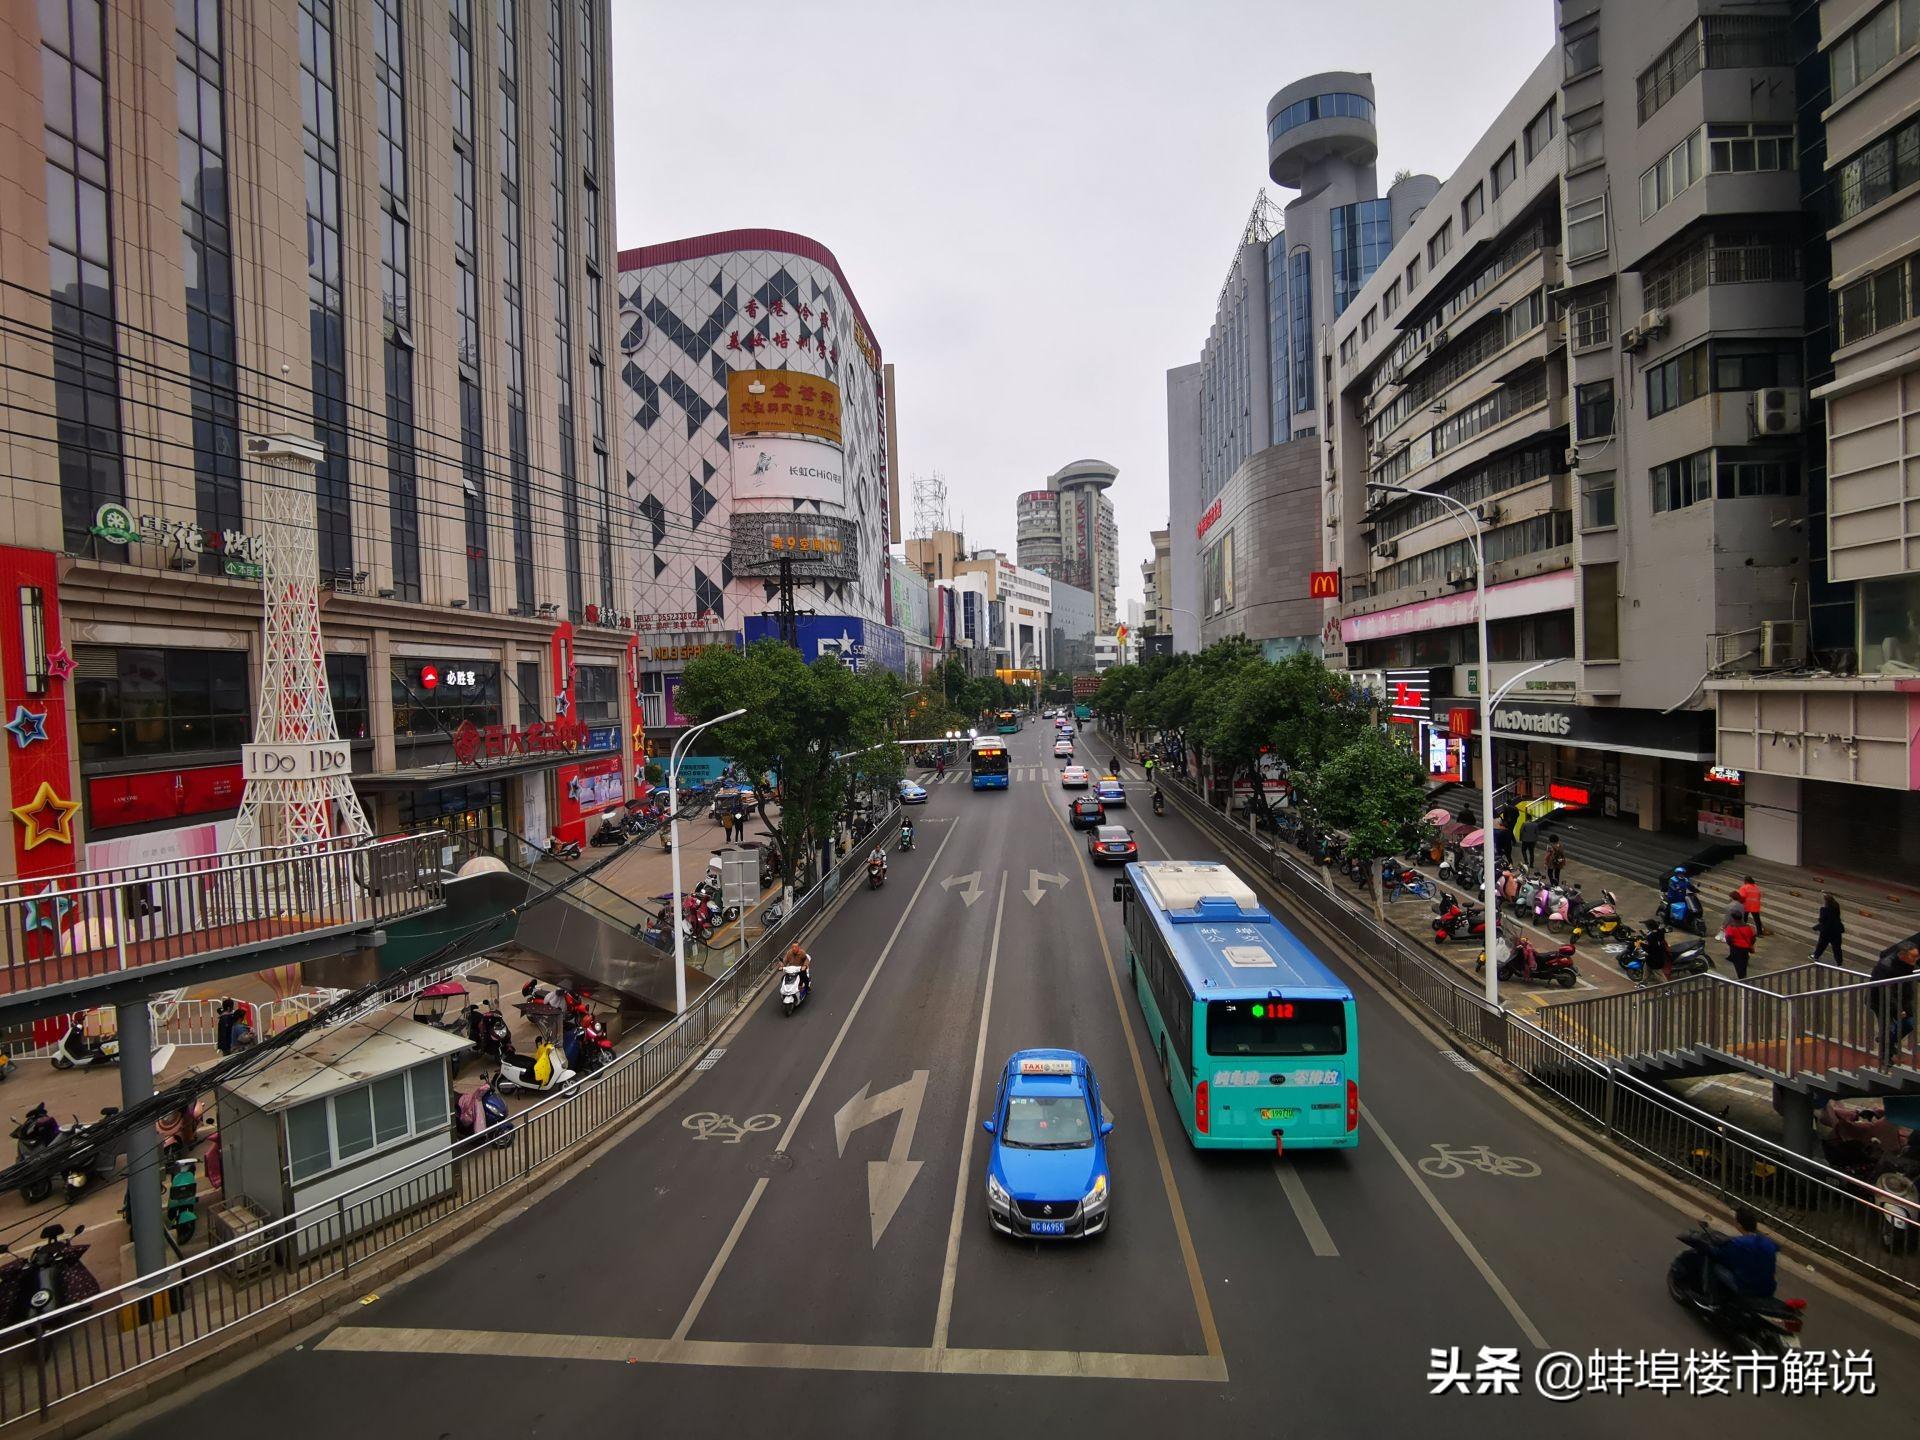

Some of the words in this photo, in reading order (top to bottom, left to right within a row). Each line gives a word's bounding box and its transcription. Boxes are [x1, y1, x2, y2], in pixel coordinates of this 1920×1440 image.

[447, 671, 476, 686] 必胜客
[1494, 710, 1571, 735] McDonald's
